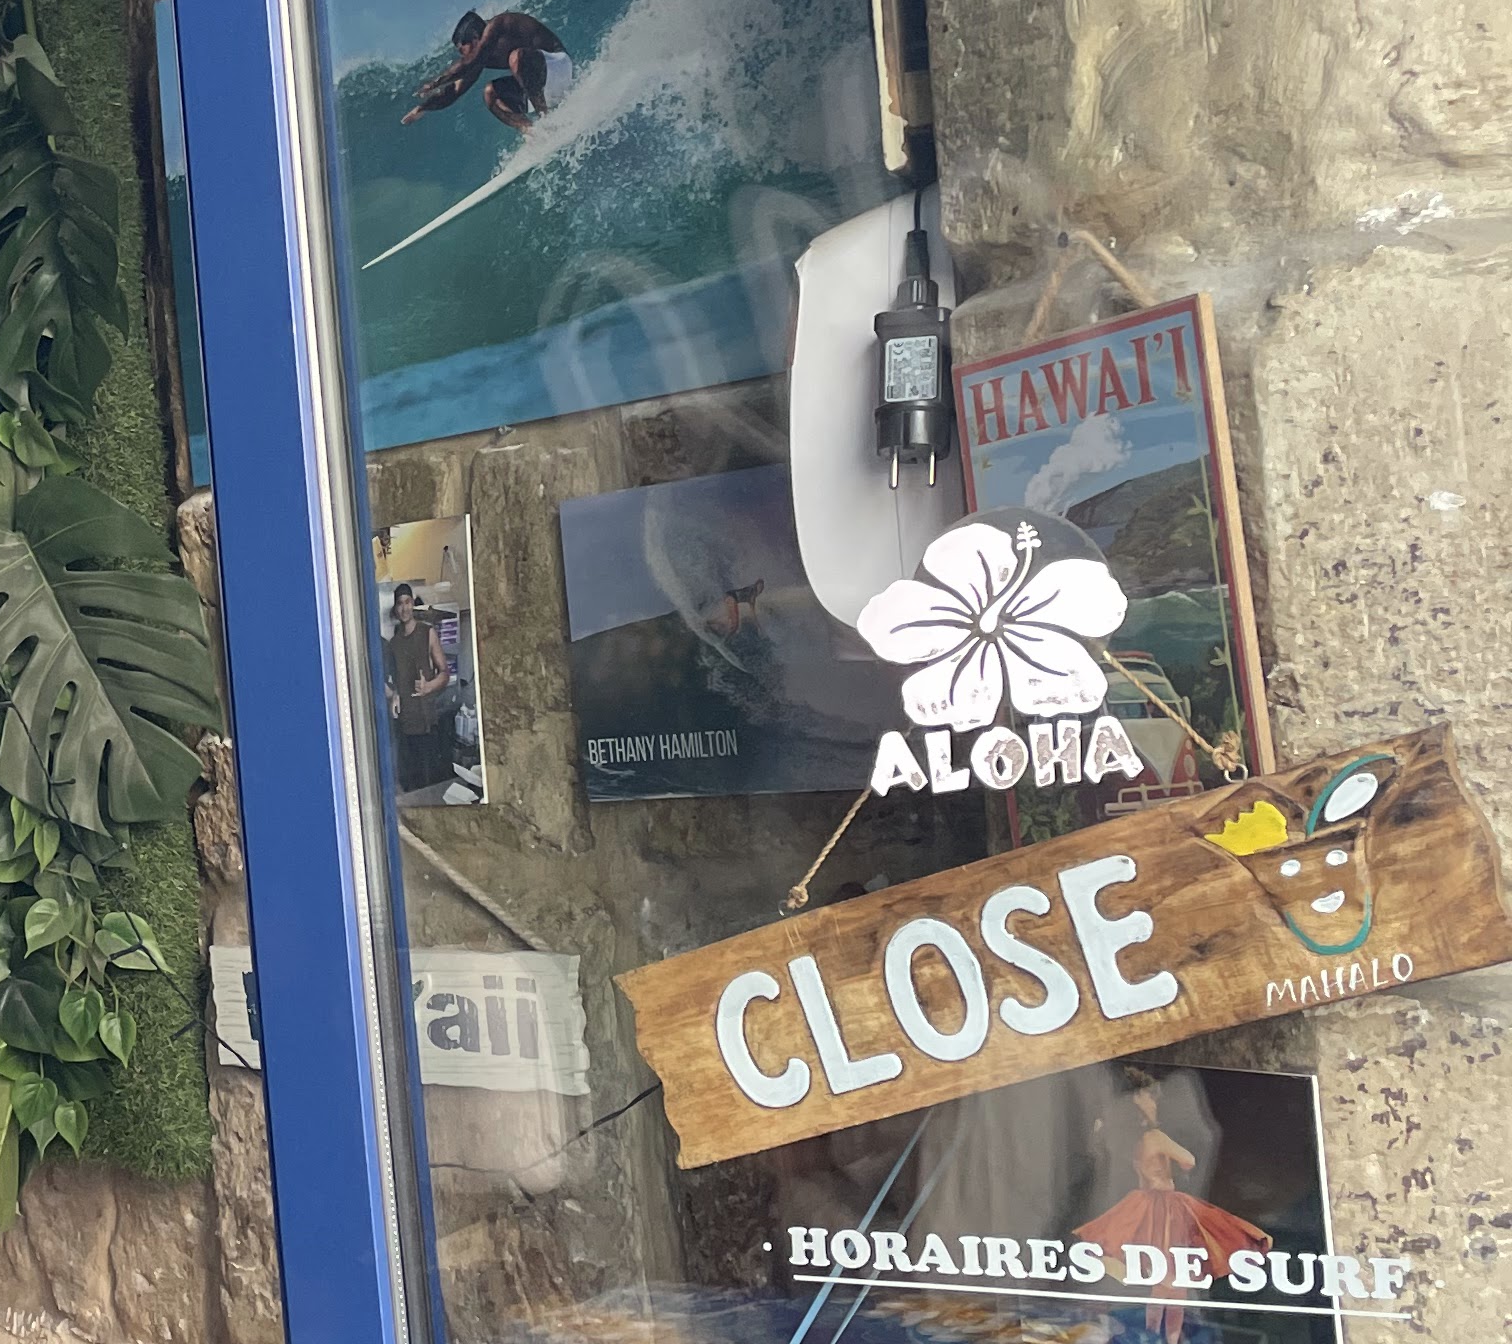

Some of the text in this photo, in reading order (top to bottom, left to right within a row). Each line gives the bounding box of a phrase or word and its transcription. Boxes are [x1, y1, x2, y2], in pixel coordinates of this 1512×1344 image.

[588, 729, 738, 765] BETHANY HAMILTON
[870, 716, 1145, 797] ALOHA
[715, 854, 1179, 1109] CLOSE
[1266, 953, 1414, 1008] MAHALO
[787, 1226, 1413, 1300] HORAIRES DE SURF
